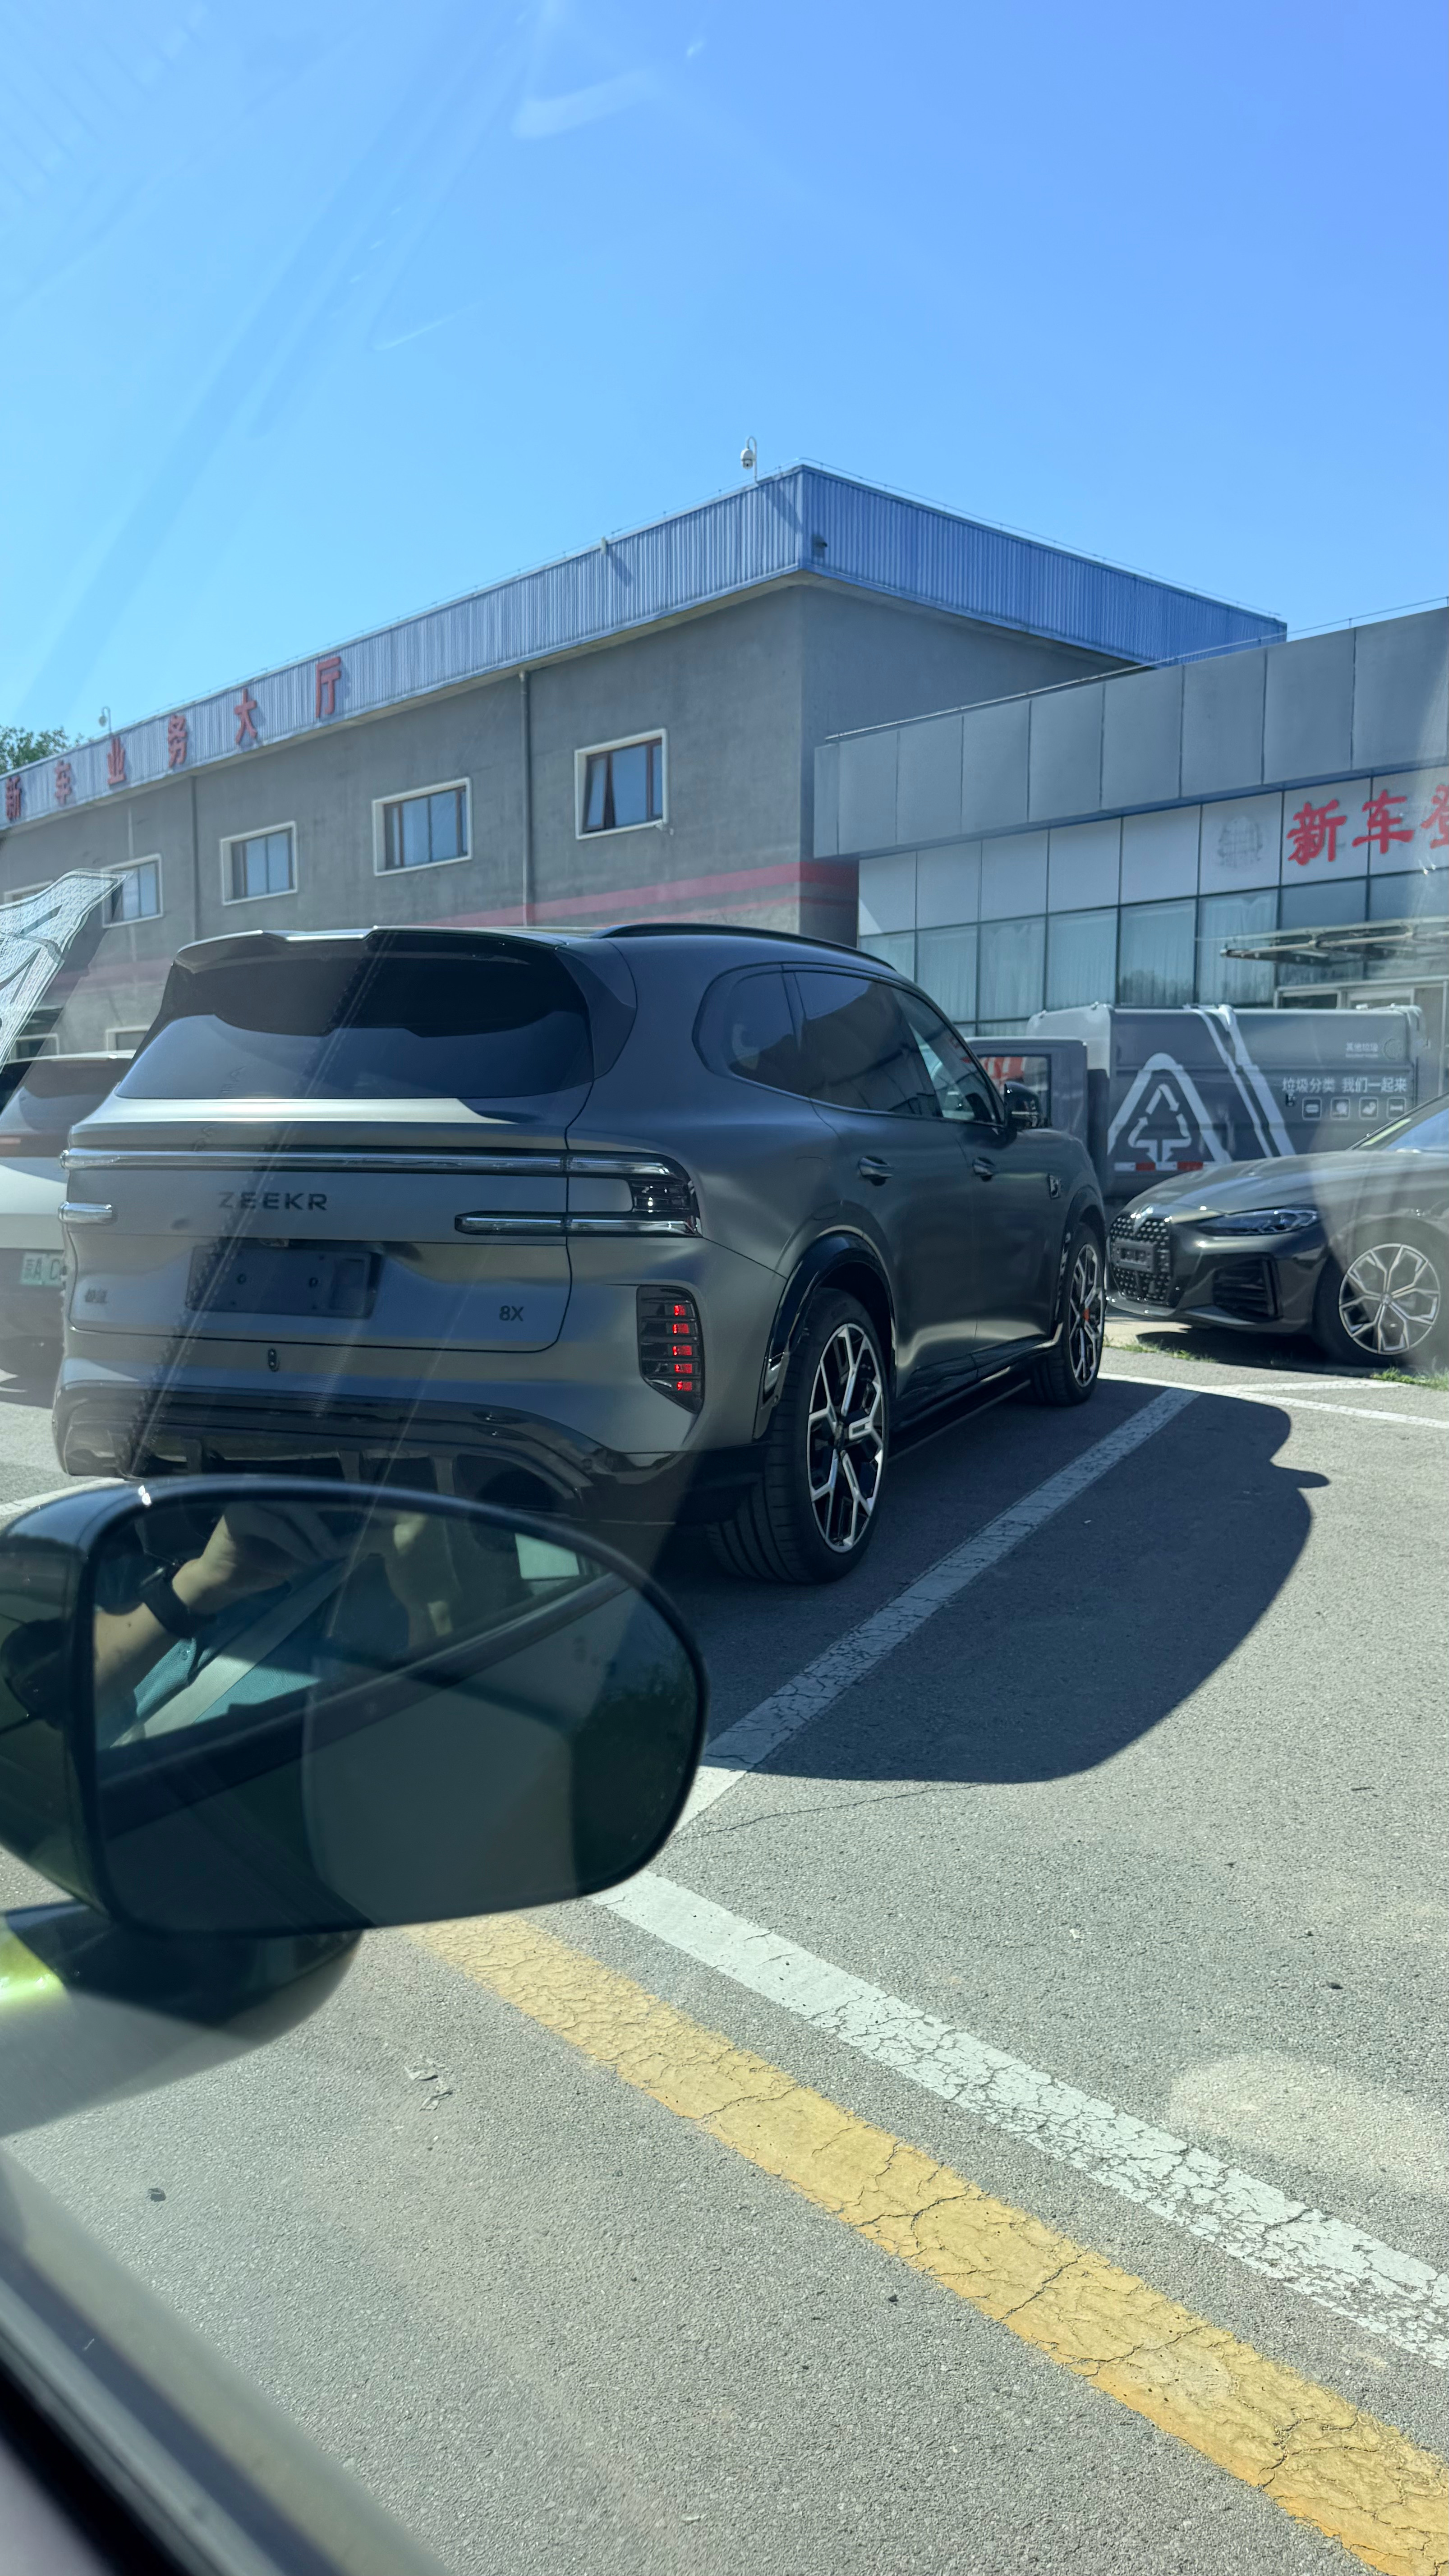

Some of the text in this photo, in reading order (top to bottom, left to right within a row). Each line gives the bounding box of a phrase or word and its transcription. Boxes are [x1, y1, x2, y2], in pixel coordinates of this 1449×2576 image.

[6, 656, 342, 821] 新车业务大厅
[1282, 1077, 1407, 1093] 垃圾分类 我们一起来
[219, 1191, 327, 1211] ZEEKR
[499, 1305, 524, 1322] 8X
